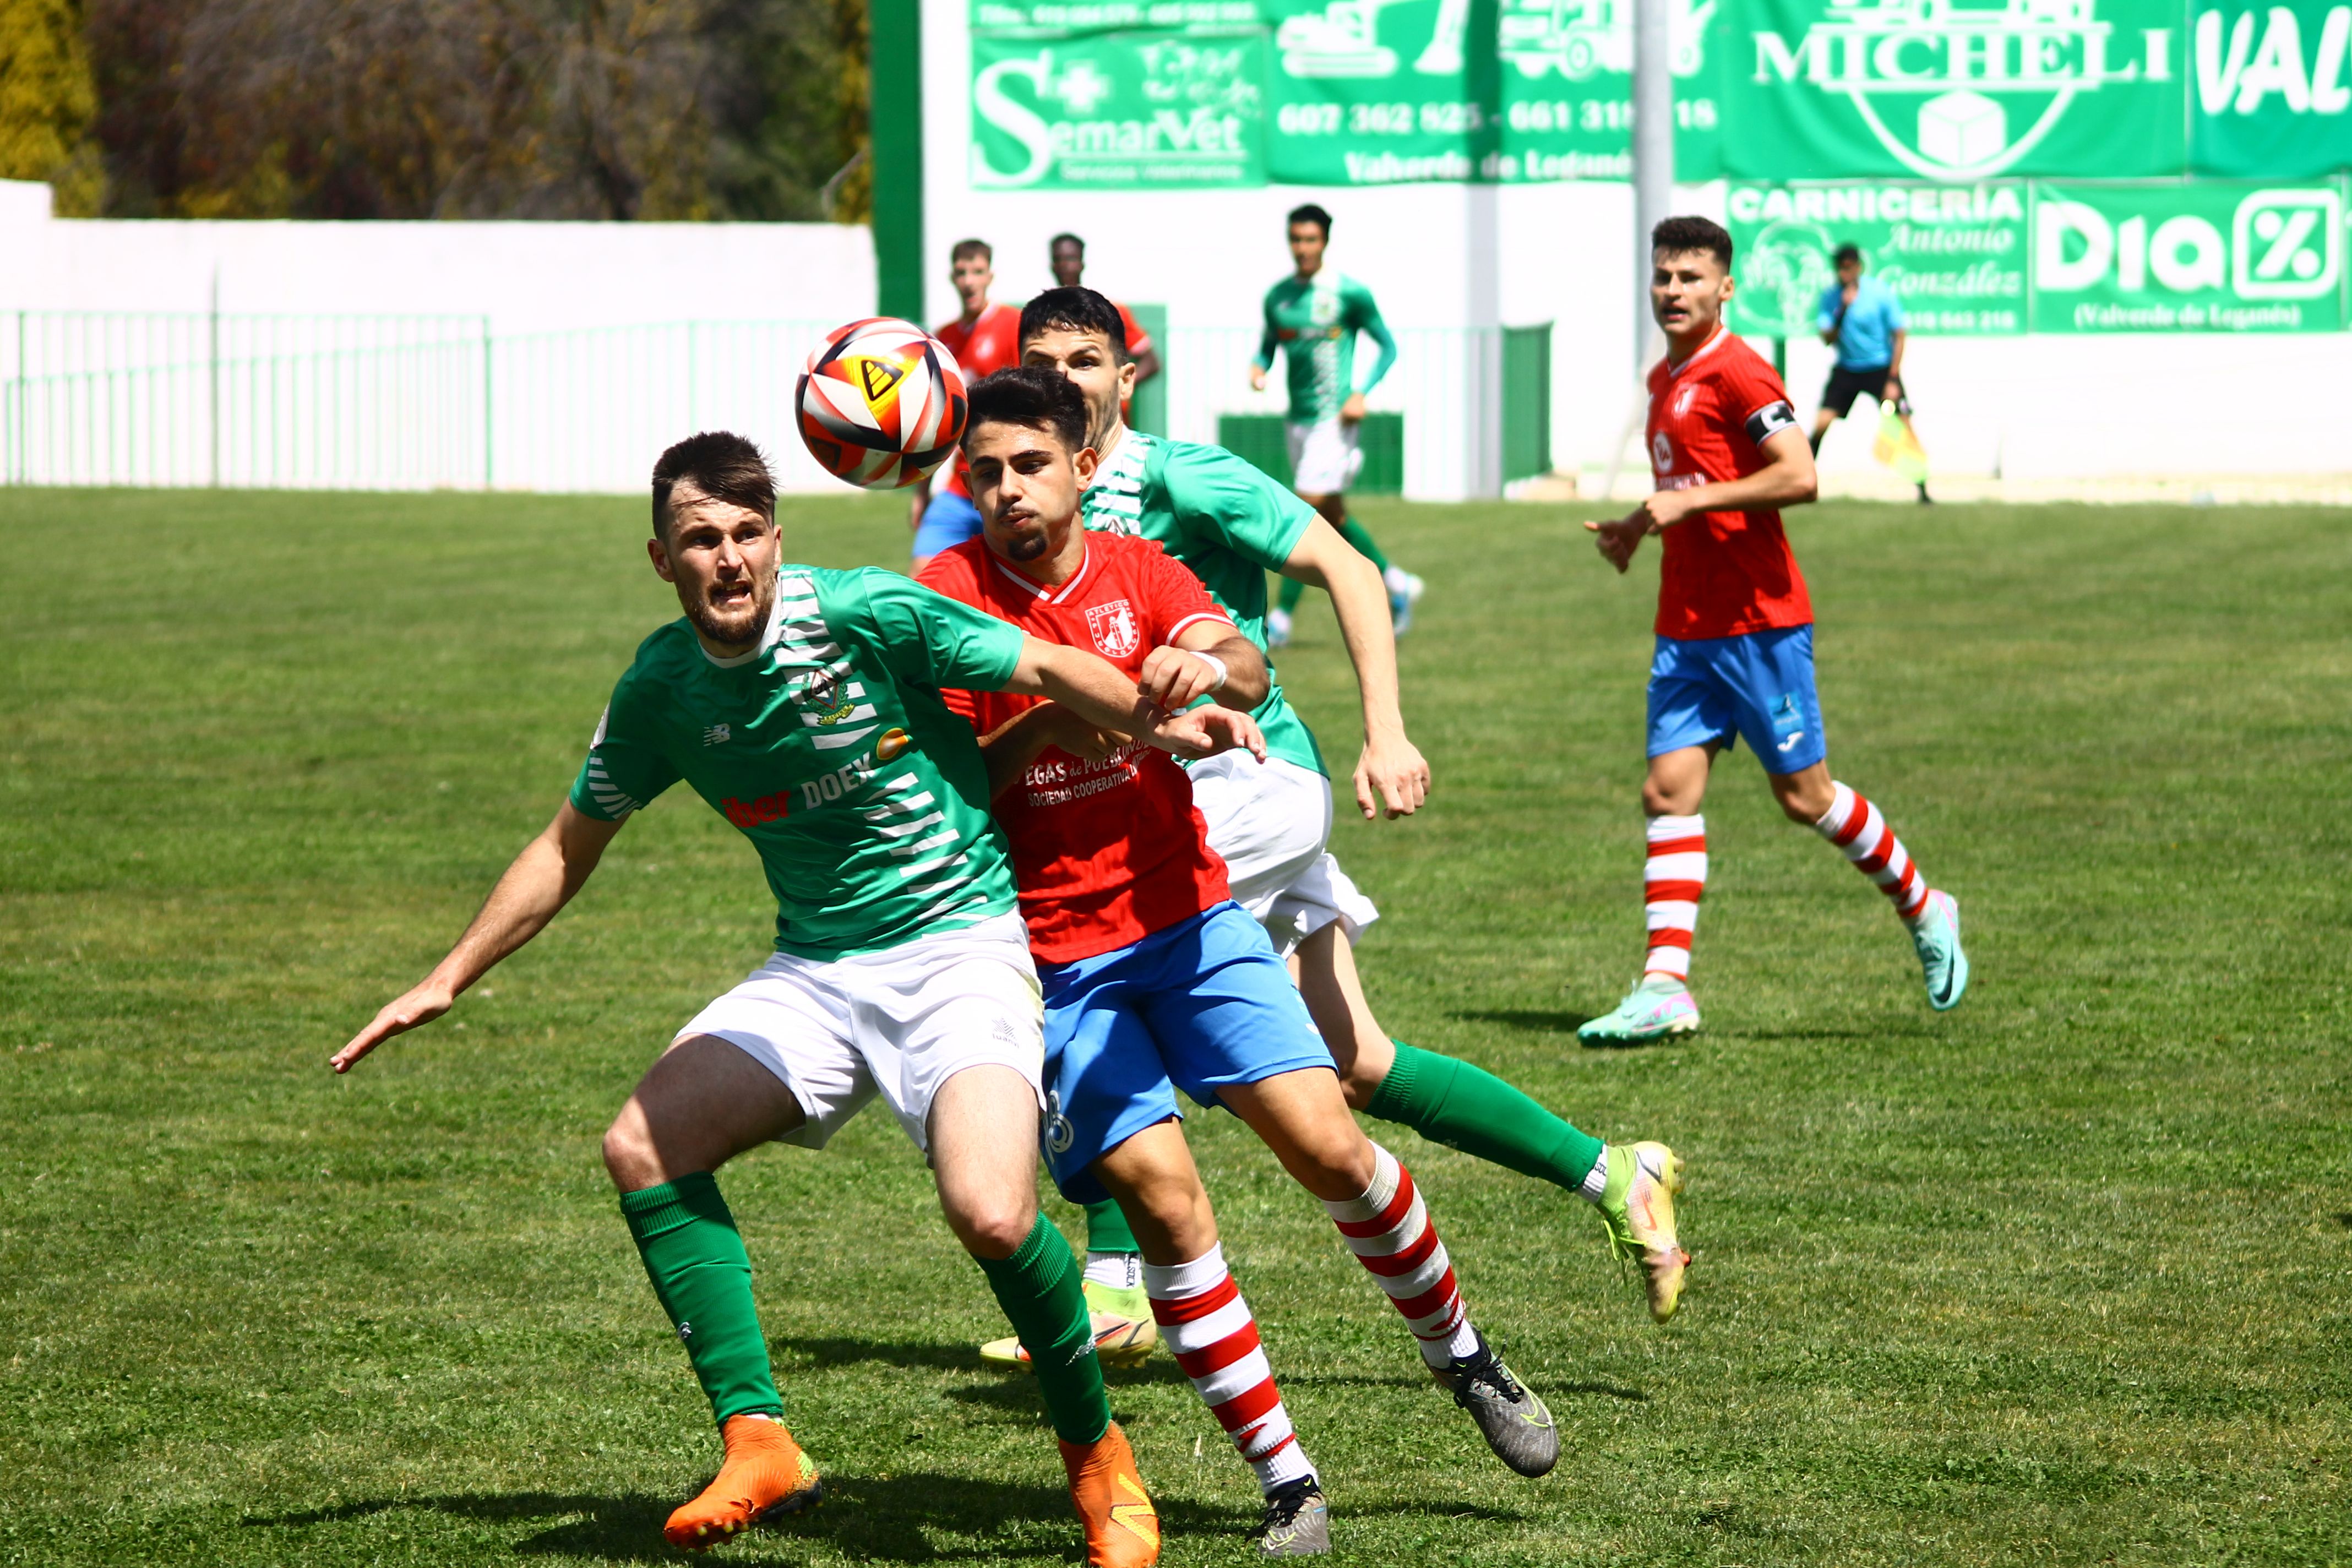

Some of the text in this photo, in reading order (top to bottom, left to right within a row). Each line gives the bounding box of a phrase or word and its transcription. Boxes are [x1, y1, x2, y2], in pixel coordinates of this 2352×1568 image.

[1751, 28, 2174, 83] MICHELI
[2195, 6, 2352, 115] VAL
[1480, 151, 1517, 178] de
[1525, 149, 1635, 181] Legané
[1729, 182, 2023, 220] CARNICERÍA
[1877, 222, 2014, 258] Antonio
[720, 751, 871, 828] iber DOEX
[1014, 761, 1068, 786] EGAS
[1027, 787, 1072, 807] SOCIEDAD
[1073, 769, 1131, 798] COOPERATIVA
